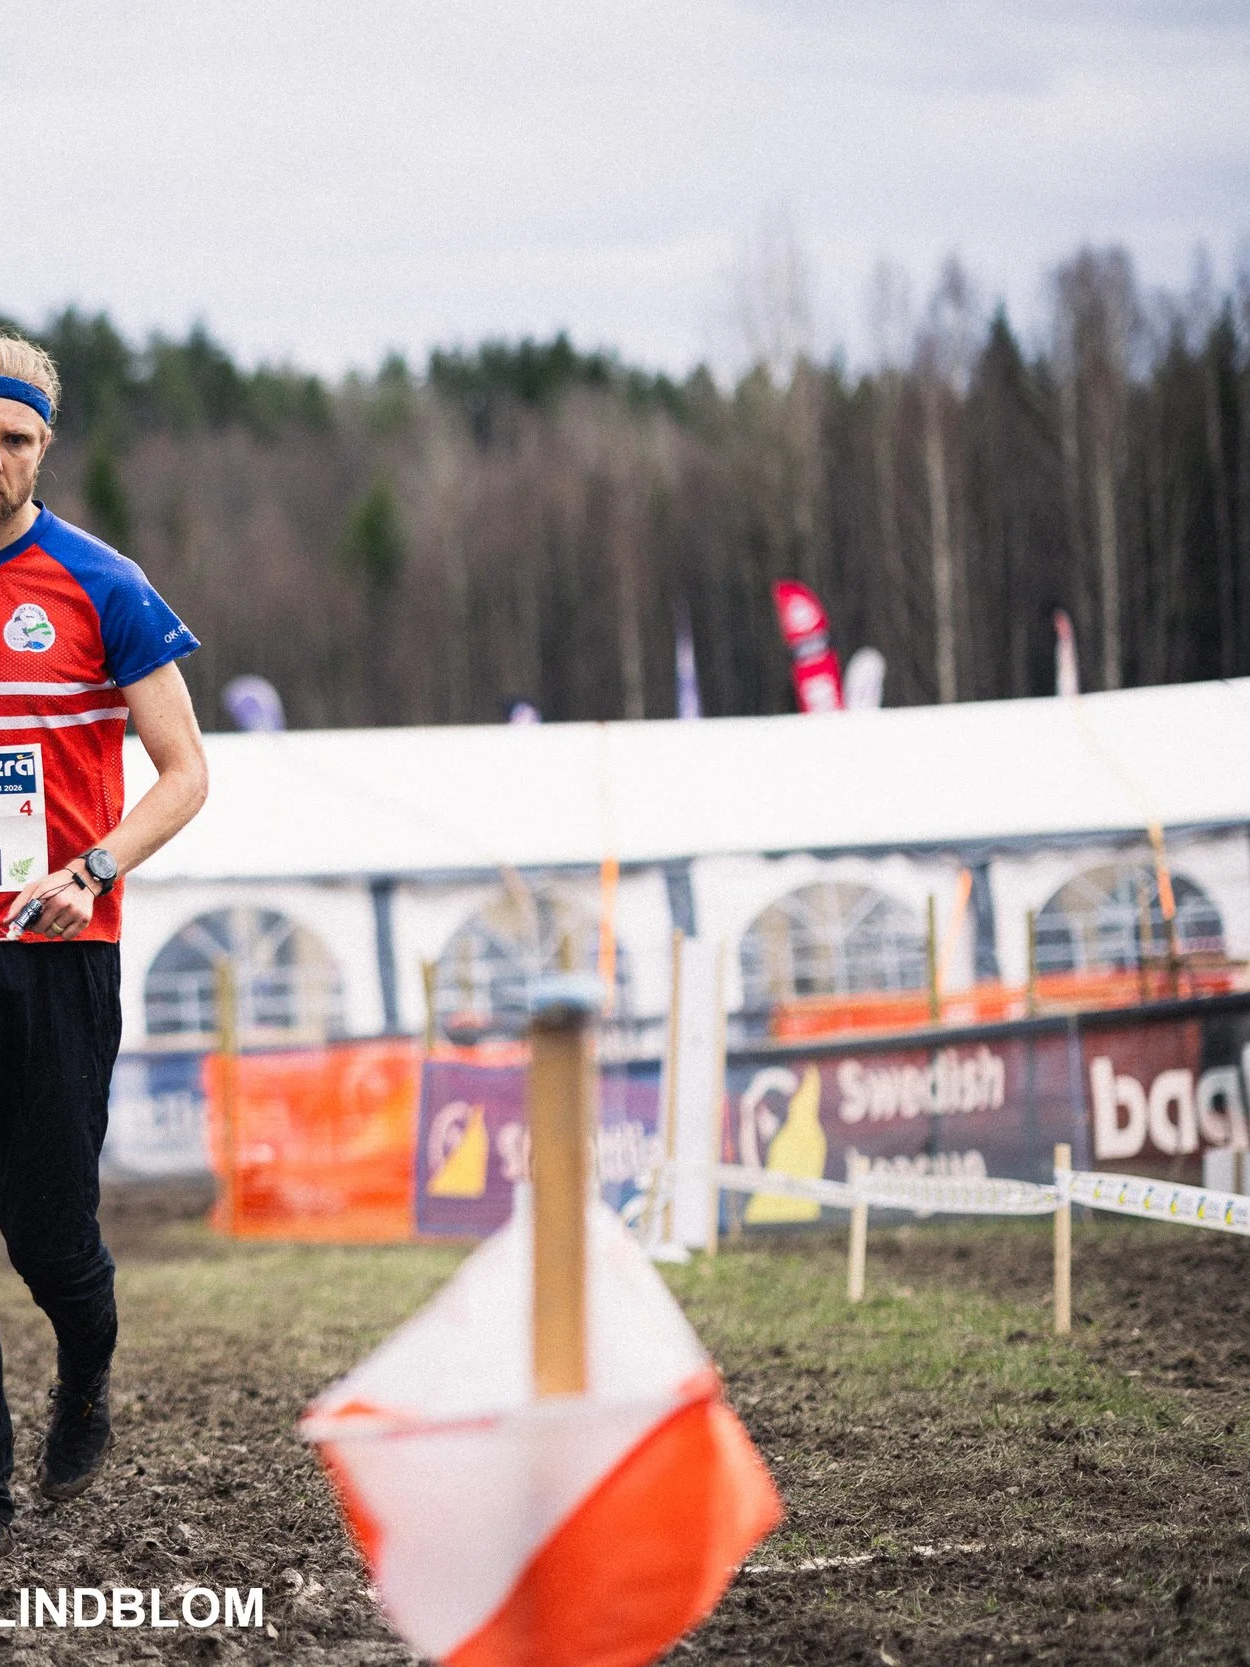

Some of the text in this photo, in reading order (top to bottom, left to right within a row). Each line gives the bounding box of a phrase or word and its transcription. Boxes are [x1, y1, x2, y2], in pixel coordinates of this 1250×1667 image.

[4, 784, 23, 792] 2026
[20, 800, 33, 816] 4
[1089, 1041, 1250, 1159] bag
